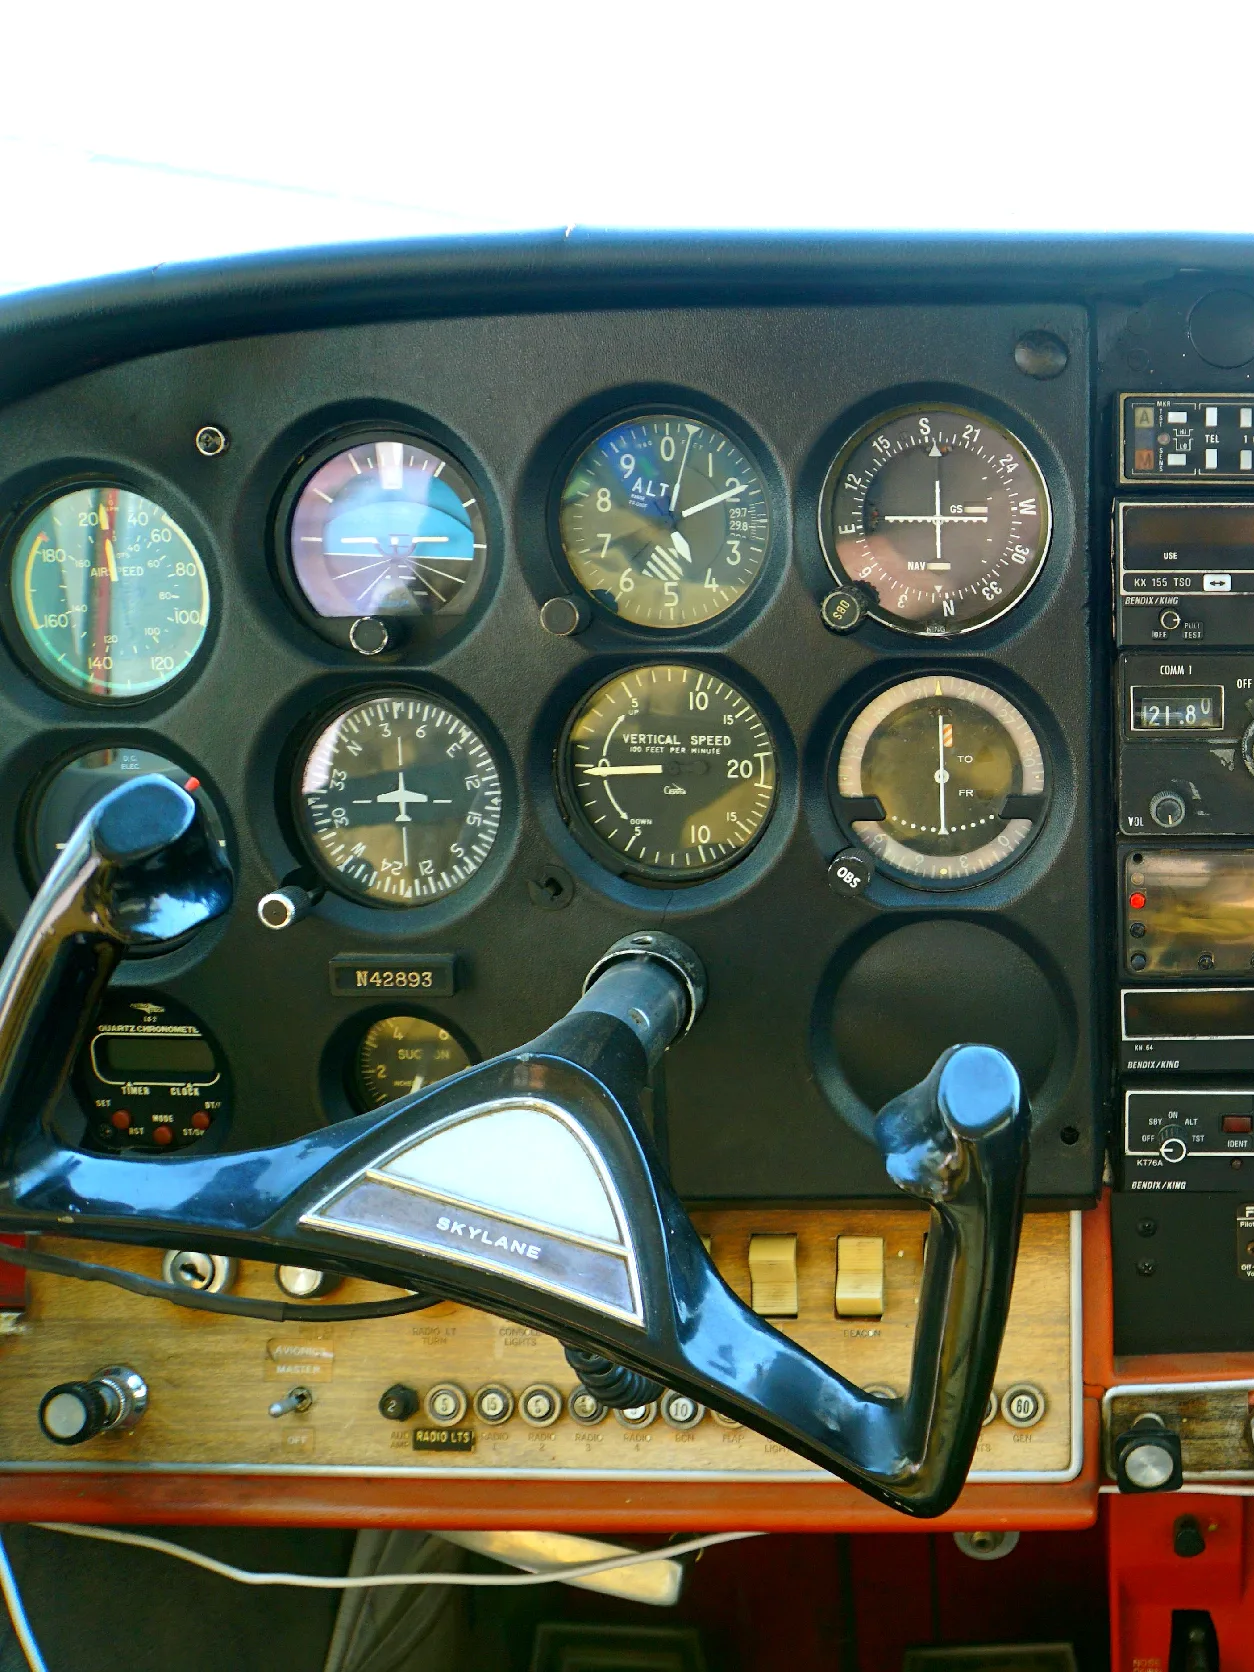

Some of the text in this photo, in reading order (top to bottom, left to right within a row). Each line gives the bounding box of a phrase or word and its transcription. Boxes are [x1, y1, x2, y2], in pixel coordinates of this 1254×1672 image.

[962, 424, 981, 443] 21
[1205, 435, 1219, 443] TEL
[1243, 435, 1248, 443] 1
[872, 435, 891, 452] 15
[620, 454, 636, 479] 9
[999, 453, 1019, 474] 24
[632, 477, 669, 497] ALT
[844, 473, 862, 491] 12
[596, 488, 611, 512] 8
[950, 505, 963, 513] GS
[79, 512, 99, 526] 20
[151, 528, 172, 542] 60
[596, 533, 612, 558] 7
[726, 540, 741, 565] 3
[176, 563, 196, 576] 80
[908, 561, 926, 570] NAV
[1134, 578, 1191, 587] KX 155 TSO
[1125, 596, 1179, 605] BENDIX/KING
[44, 614, 68, 627] 160
[174, 610, 200, 624] 100
[88, 656, 113, 669] 140
[151, 656, 174, 670] 120
[1160, 665, 1192, 675] COMM 1
[1237, 679, 1252, 689] OFF
[689, 691, 709, 710] 10
[723, 715, 734, 725] 15
[379, 723, 391, 738] 3
[416, 725, 427, 738] 6
[622, 734, 731, 746] VERTICAL SPEED
[958, 755, 973, 763] TO
[727, 760, 753, 778] 20
[332, 807, 349, 828] 30
[466, 811, 482, 826] 15
[727, 812, 738, 821] 15
[690, 825, 710, 844] 10
[836, 867, 861, 889] OBS
[355, 970, 433, 987] N42893
[1127, 1061, 1180, 1069] BENDIX/KING
[121, 1087, 150, 1095] TIMER
[1227, 1140, 1248, 1148] IDENT
[1131, 1181, 1186, 1190] BENDIX/KING
[436, 1216, 541, 1260] SKYLANE
[673, 1402, 688, 1417] 10
[1016, 1399, 1029, 1413] 60
[416, 1431, 447, 1442] RADIO
[451, 1431, 470, 1443] LTS
